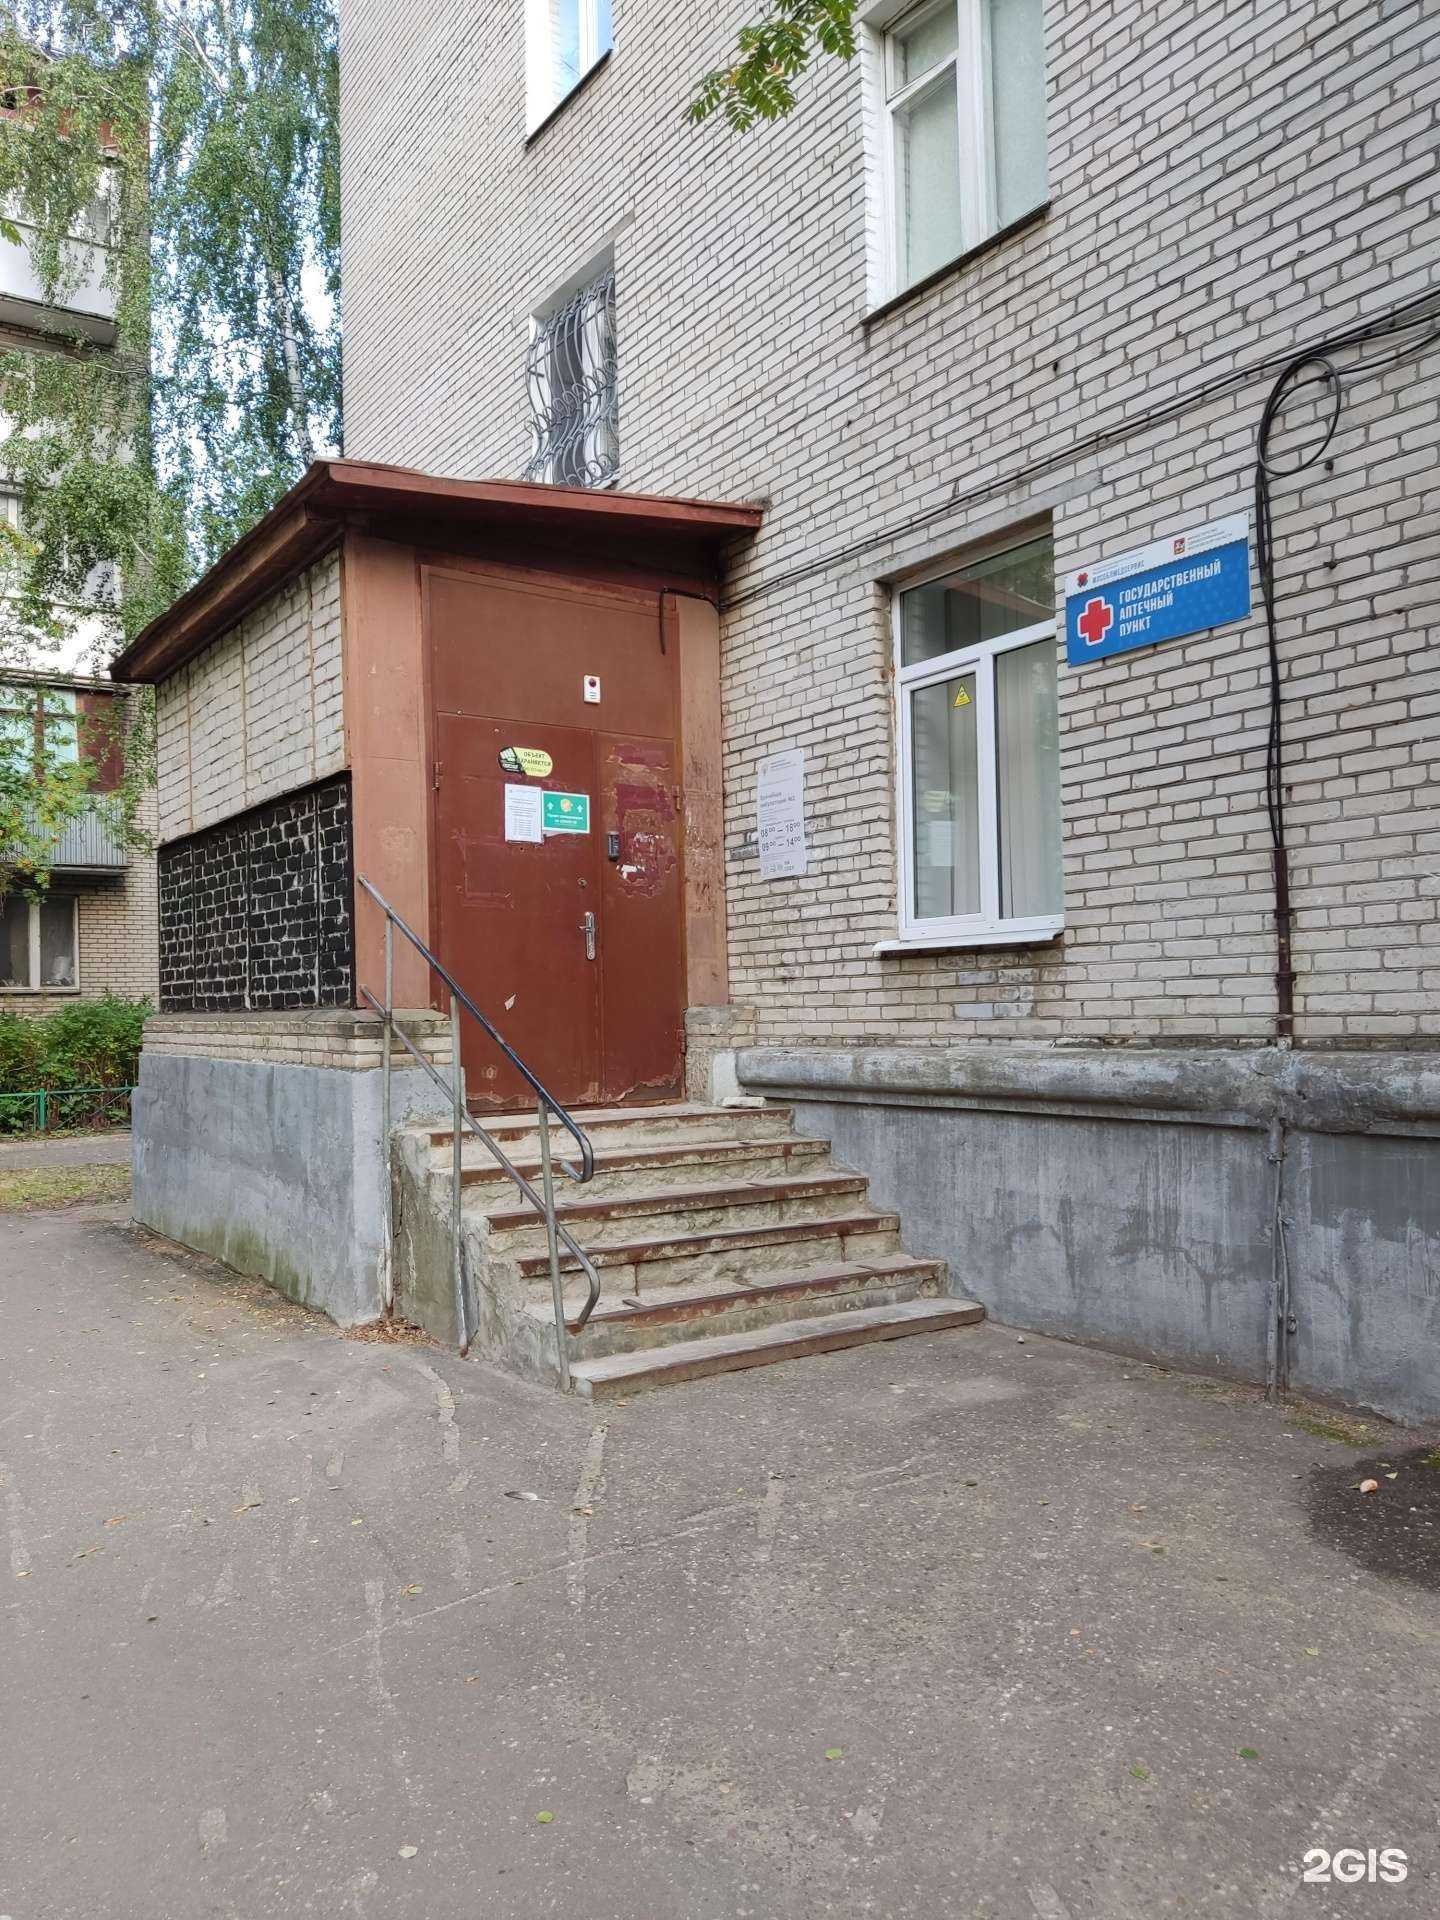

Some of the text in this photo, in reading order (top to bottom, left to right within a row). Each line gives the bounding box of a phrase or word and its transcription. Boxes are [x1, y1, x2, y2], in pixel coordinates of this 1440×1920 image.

[1119, 558, 1221, 604] ГОСУДАРСТВЕННЫЙ
[1119, 591, 1174, 621] АПТЕЧНЫЙ
[1119, 615, 1152, 637] ПУНКТ
[523, 751, 545, 759] ОБЪЕКТ
